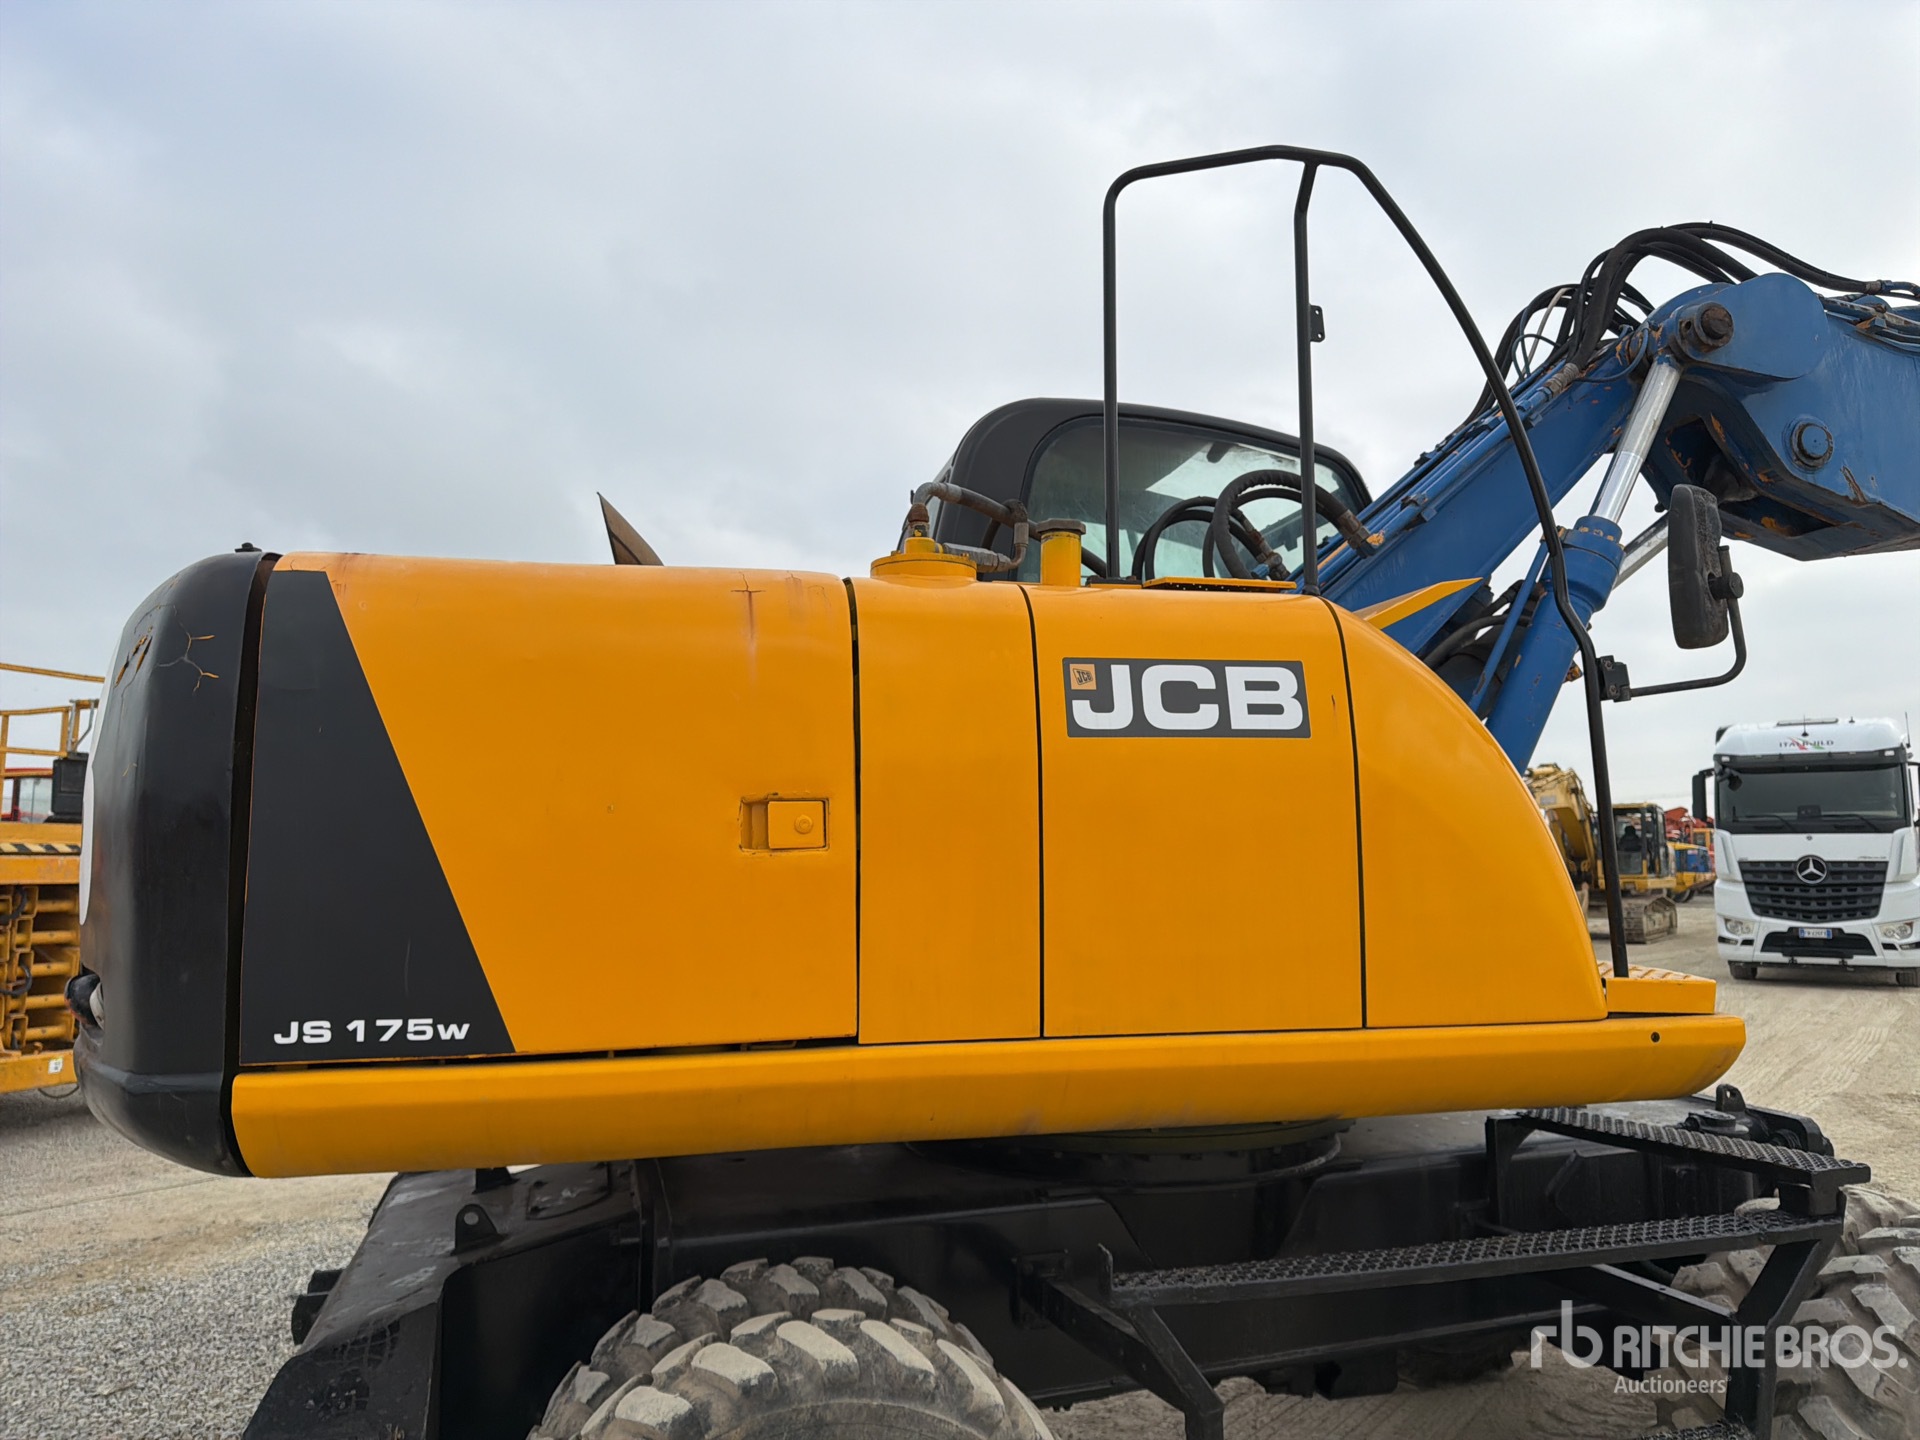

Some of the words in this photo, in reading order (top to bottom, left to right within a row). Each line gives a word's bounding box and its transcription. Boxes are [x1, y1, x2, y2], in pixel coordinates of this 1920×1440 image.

[1075, 670, 1092, 684] JCB
[1071, 664, 1304, 730] JCB
[273, 1020, 332, 1045] JS
